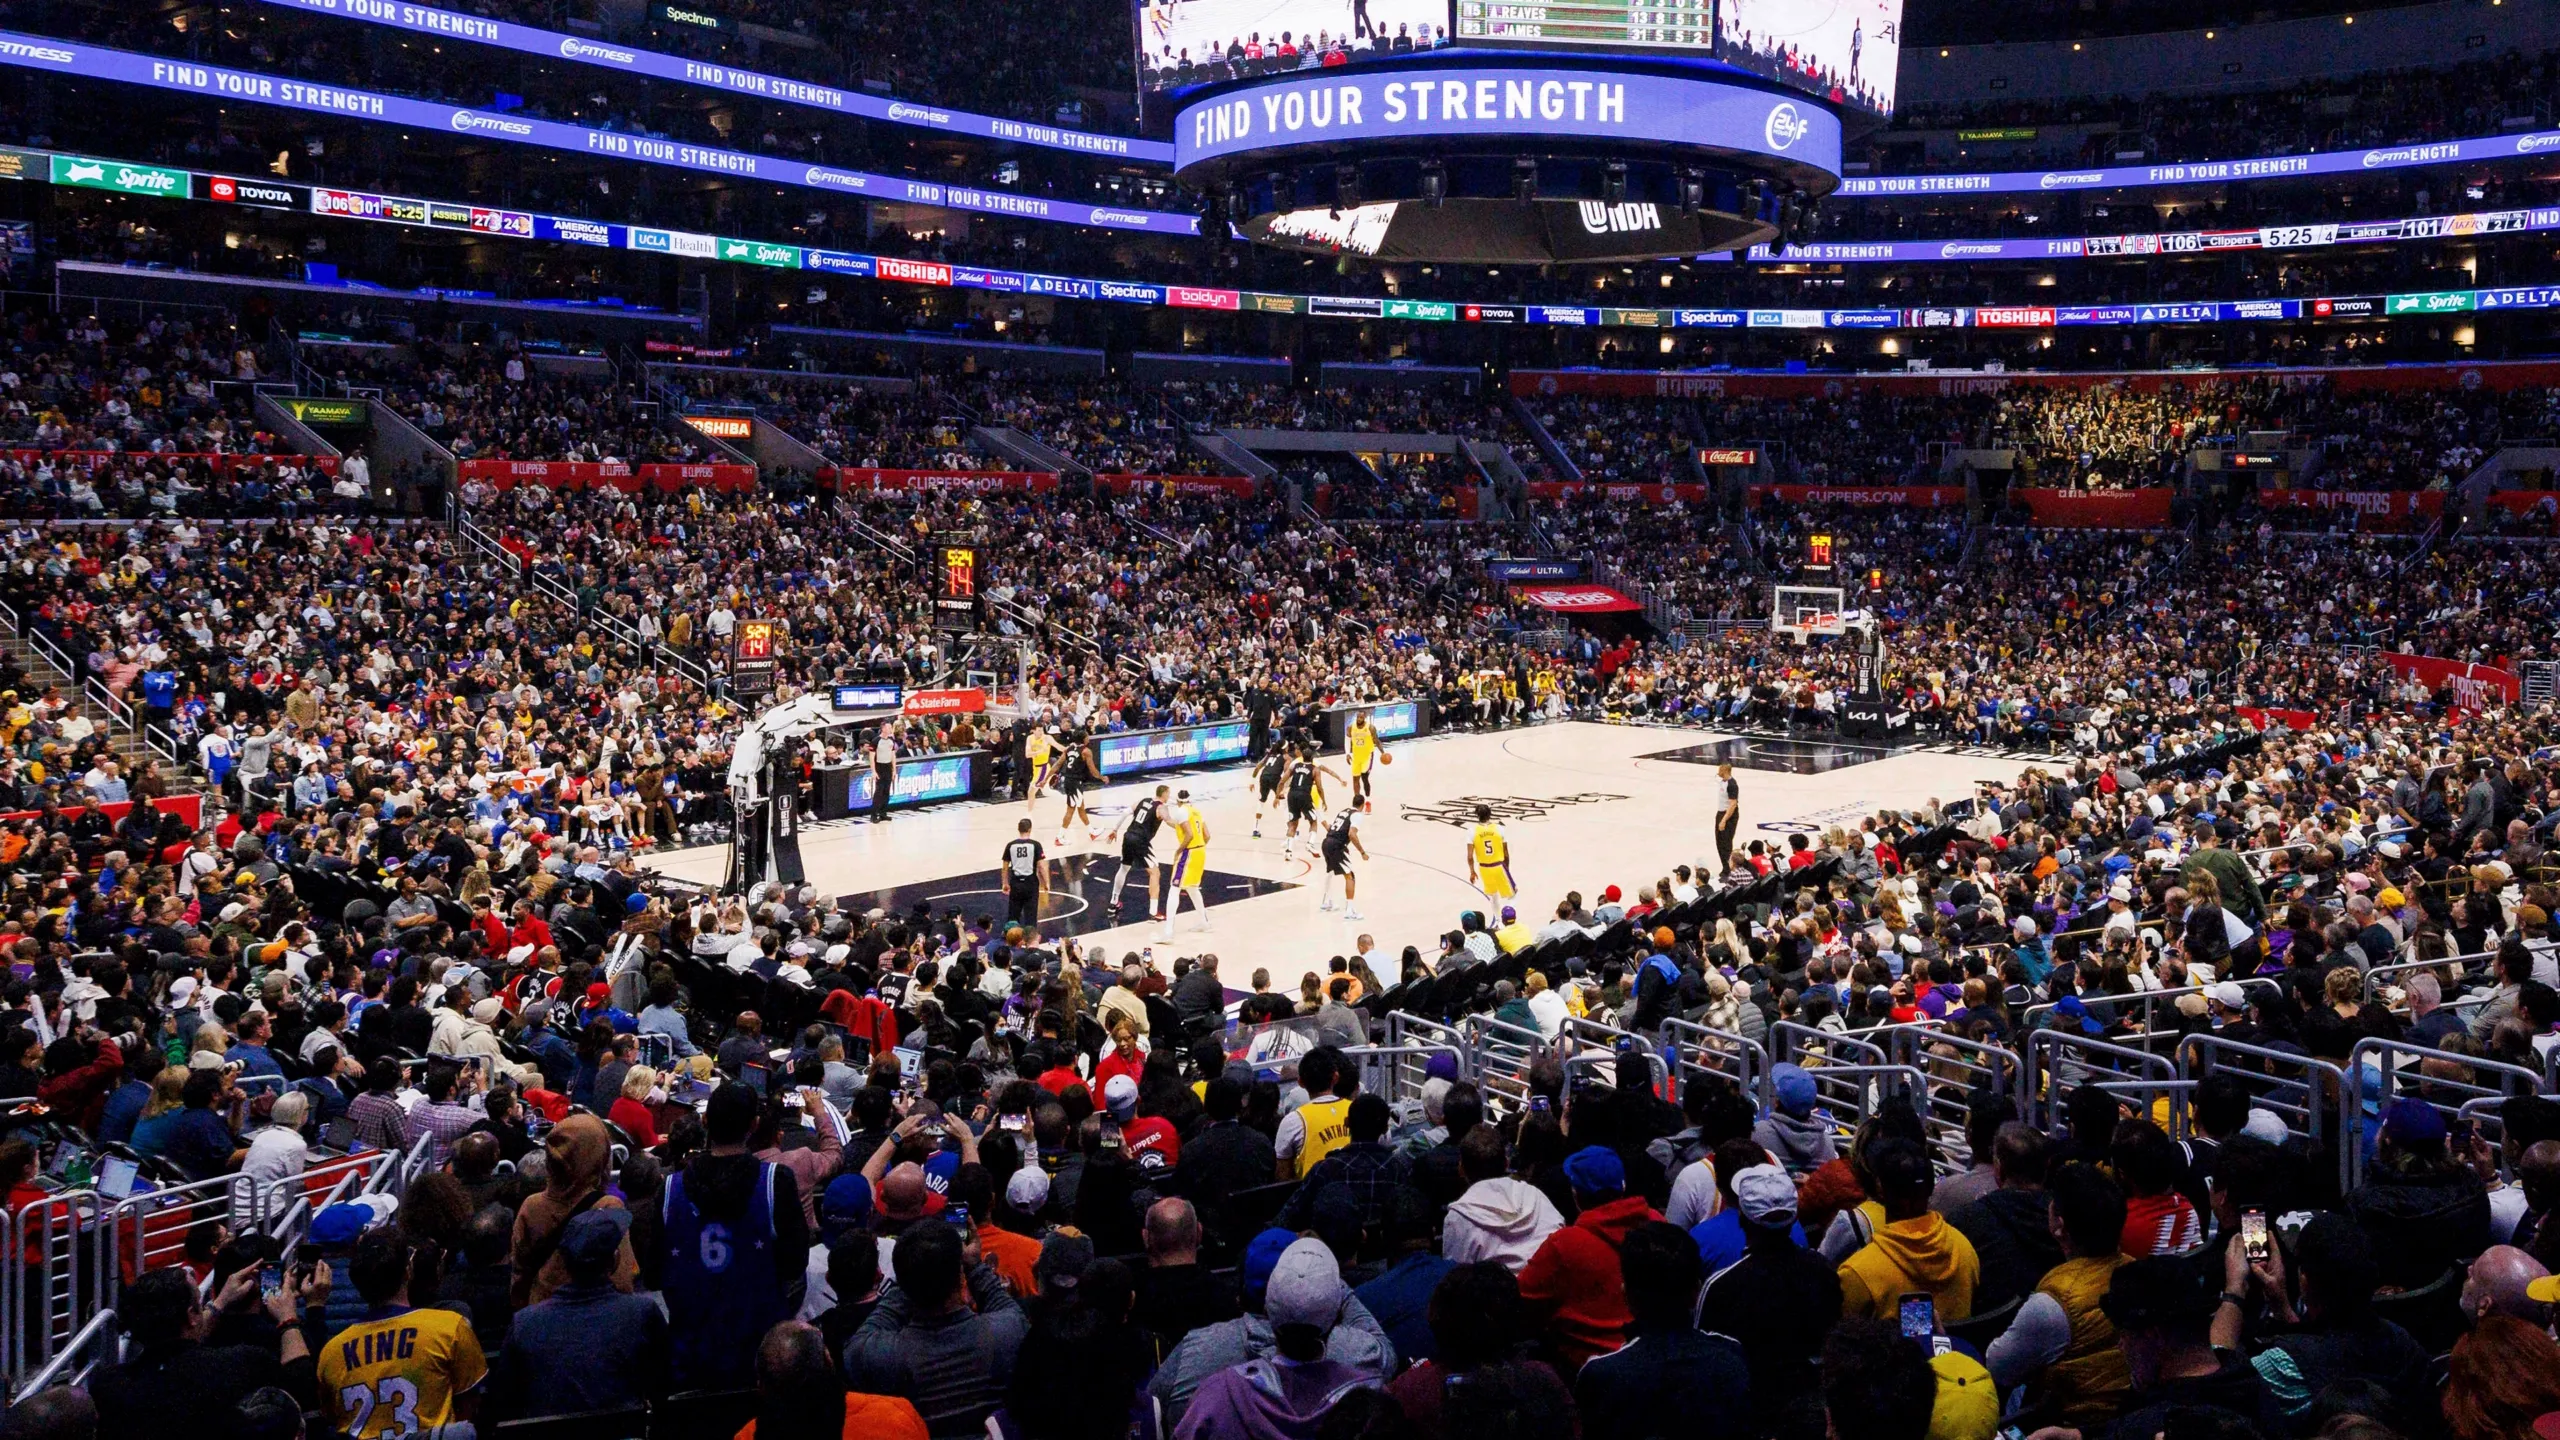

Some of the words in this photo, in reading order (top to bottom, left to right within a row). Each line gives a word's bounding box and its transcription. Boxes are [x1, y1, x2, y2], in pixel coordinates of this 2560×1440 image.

[345, 0, 396, 20] YOUR
[403, 7, 498, 40] STRENGTH
[667, 6, 717, 28] Spectrum
[1489, 5, 1546, 20] A.REAVES
[1632, 12, 1649, 24] 13
[1656, 13, 1665, 25] 8
[1676, 14, 1685, 26] 5
[1694, 15, 1702, 27] 1
[1490, 24, 1541, 36] L.JAMES
[1632, 29, 1648, 41] 31
[1655, 30, 1664, 42] 5
[1675, 31, 1684, 43] 5
[1693, 32, 1702, 44] 2
[580, 43, 636, 63] FITNESS
[153, 62, 208, 88] FIND
[215, 72, 272, 98] YOUR
[281, 83, 384, 115] STRENGTH
[687, 64, 722, 83] FIND
[728, 71, 766, 92] YOUR
[772, 80, 842, 107] STRENGTH
[1196, 100, 1250, 148] FIND
[1263, 86, 1363, 133] YOUR
[1384, 80, 1624, 123] STRENGTH
[472, 117, 533, 135] FITNESS
[1774, 113, 1798, 137] 24
[992, 121, 1022, 138] FIND
[1026, 127, 1058, 144] YOUR
[1062, 133, 1127, 153] STRENGTH
[589, 133, 627, 152] FIND
[633, 140, 674, 161] YOUR
[680, 145, 756, 173] STRENGTH
[2151, 168, 2185, 181] FIND
[2189, 165, 2228, 179] YOUR
[2233, 158, 2307, 176] STRENGTH
[115, 168, 176, 190] Sprite
[237, 186, 292, 202] TOYOTA
[1844, 180, 1876, 192] FIND
[1880, 179, 1915, 191] YOUR
[1921, 177, 1991, 190] STRENGTH
[2056, 173, 2103, 184] FITNESS
[820, 172, 866, 188] FITNESS
[908, 184, 939, 201] FIND
[944, 188, 980, 207] YOUR
[985, 195, 1048, 215] STRENGTH
[326, 196, 348, 212] 106
[360, 200, 380, 215] 101
[392, 204, 424, 220] 5:25
[432, 210, 468, 222] ASSISTS
[474, 214, 490, 227] 27
[504, 217, 519, 231] 24
[1103, 212, 1148, 225] FITNESS
[553, 220, 608, 235] AMERICAN
[2093, 245, 2100, 253] 2
[2109, 244, 2116, 252] 3
[2165, 236, 2196, 251] 106
[2210, 235, 2254, 247] Clippers
[2269, 228, 2312, 246] 5:25
[2325, 231, 2333, 243] 4
[2350, 227, 2388, 238] Lakers
[2407, 221, 2438, 237] 101
[2493, 220, 2502, 231] 2
[2514, 219, 2522, 230] 4
[561, 230, 609, 244] EXPRESS
[1787, 245, 1820, 257] YOUR
[1826, 245, 1893, 258] STRENGTH
[1956, 245, 2002, 254] FITNESS
[2048, 242, 2081, 254] FIND
[639, 234, 667, 247] UCLA
[673, 237, 712, 253] Health
[756, 246, 792, 263] Sprite
[823, 257, 869, 271] crypto.com
[880, 260, 949, 282] TOSHIBA
[991, 275, 1021, 287] ULTRA
[1044, 281, 1088, 295] DELTA
[1100, 283, 1156, 300] Spectrum
[1180, 289, 1227, 305] boldyn
[2234, 302, 2282, 312] AMERICAN
[2333, 302, 2372, 311] TOYOTA
[2426, 294, 2467, 309] Sprite
[2502, 291, 2560, 305] DELTA
[1415, 304, 1447, 317] Sprite
[1482, 309, 1515, 318] TOYOTA
[1543, 308, 1585, 317] AMERICAN
[1549, 315, 1585, 323] EXPRESS
[1681, 311, 1737, 325] Spectrum
[1756, 314, 1779, 323] UCLA
[1785, 313, 1818, 325] Health
[1844, 314, 1892, 324] crypto.com
[1979, 310, 2052, 324] TOSHIBA
[2098, 309, 2131, 319] ULTRA
[2158, 306, 2212, 318] DELTA
[2241, 309, 2282, 318] EXPRESS
[1806, 490, 1906, 503] CLIPPERS.COM
[947, 549, 973, 567] 5:24
[1813, 546, 1829, 562] 14
[1537, 567, 1563, 575] ULTRA
[950, 567, 972, 595] 14
[946, 600, 972, 610] TISSOT
[746, 624, 771, 639] 5:24
[749, 640, 764, 655] 14
[1356, 738, 1365, 746] 23
[1067, 757, 1074, 769] 2
[933, 769, 956, 790] Pass
[1298, 775, 1304, 786] 1
[1016, 846, 1028, 858] 83
[1484, 840, 1493, 854] 5
[701, 1223, 732, 1272] 6
[342, 1327, 418, 1371] KING
[340, 1376, 418, 1439] 23
